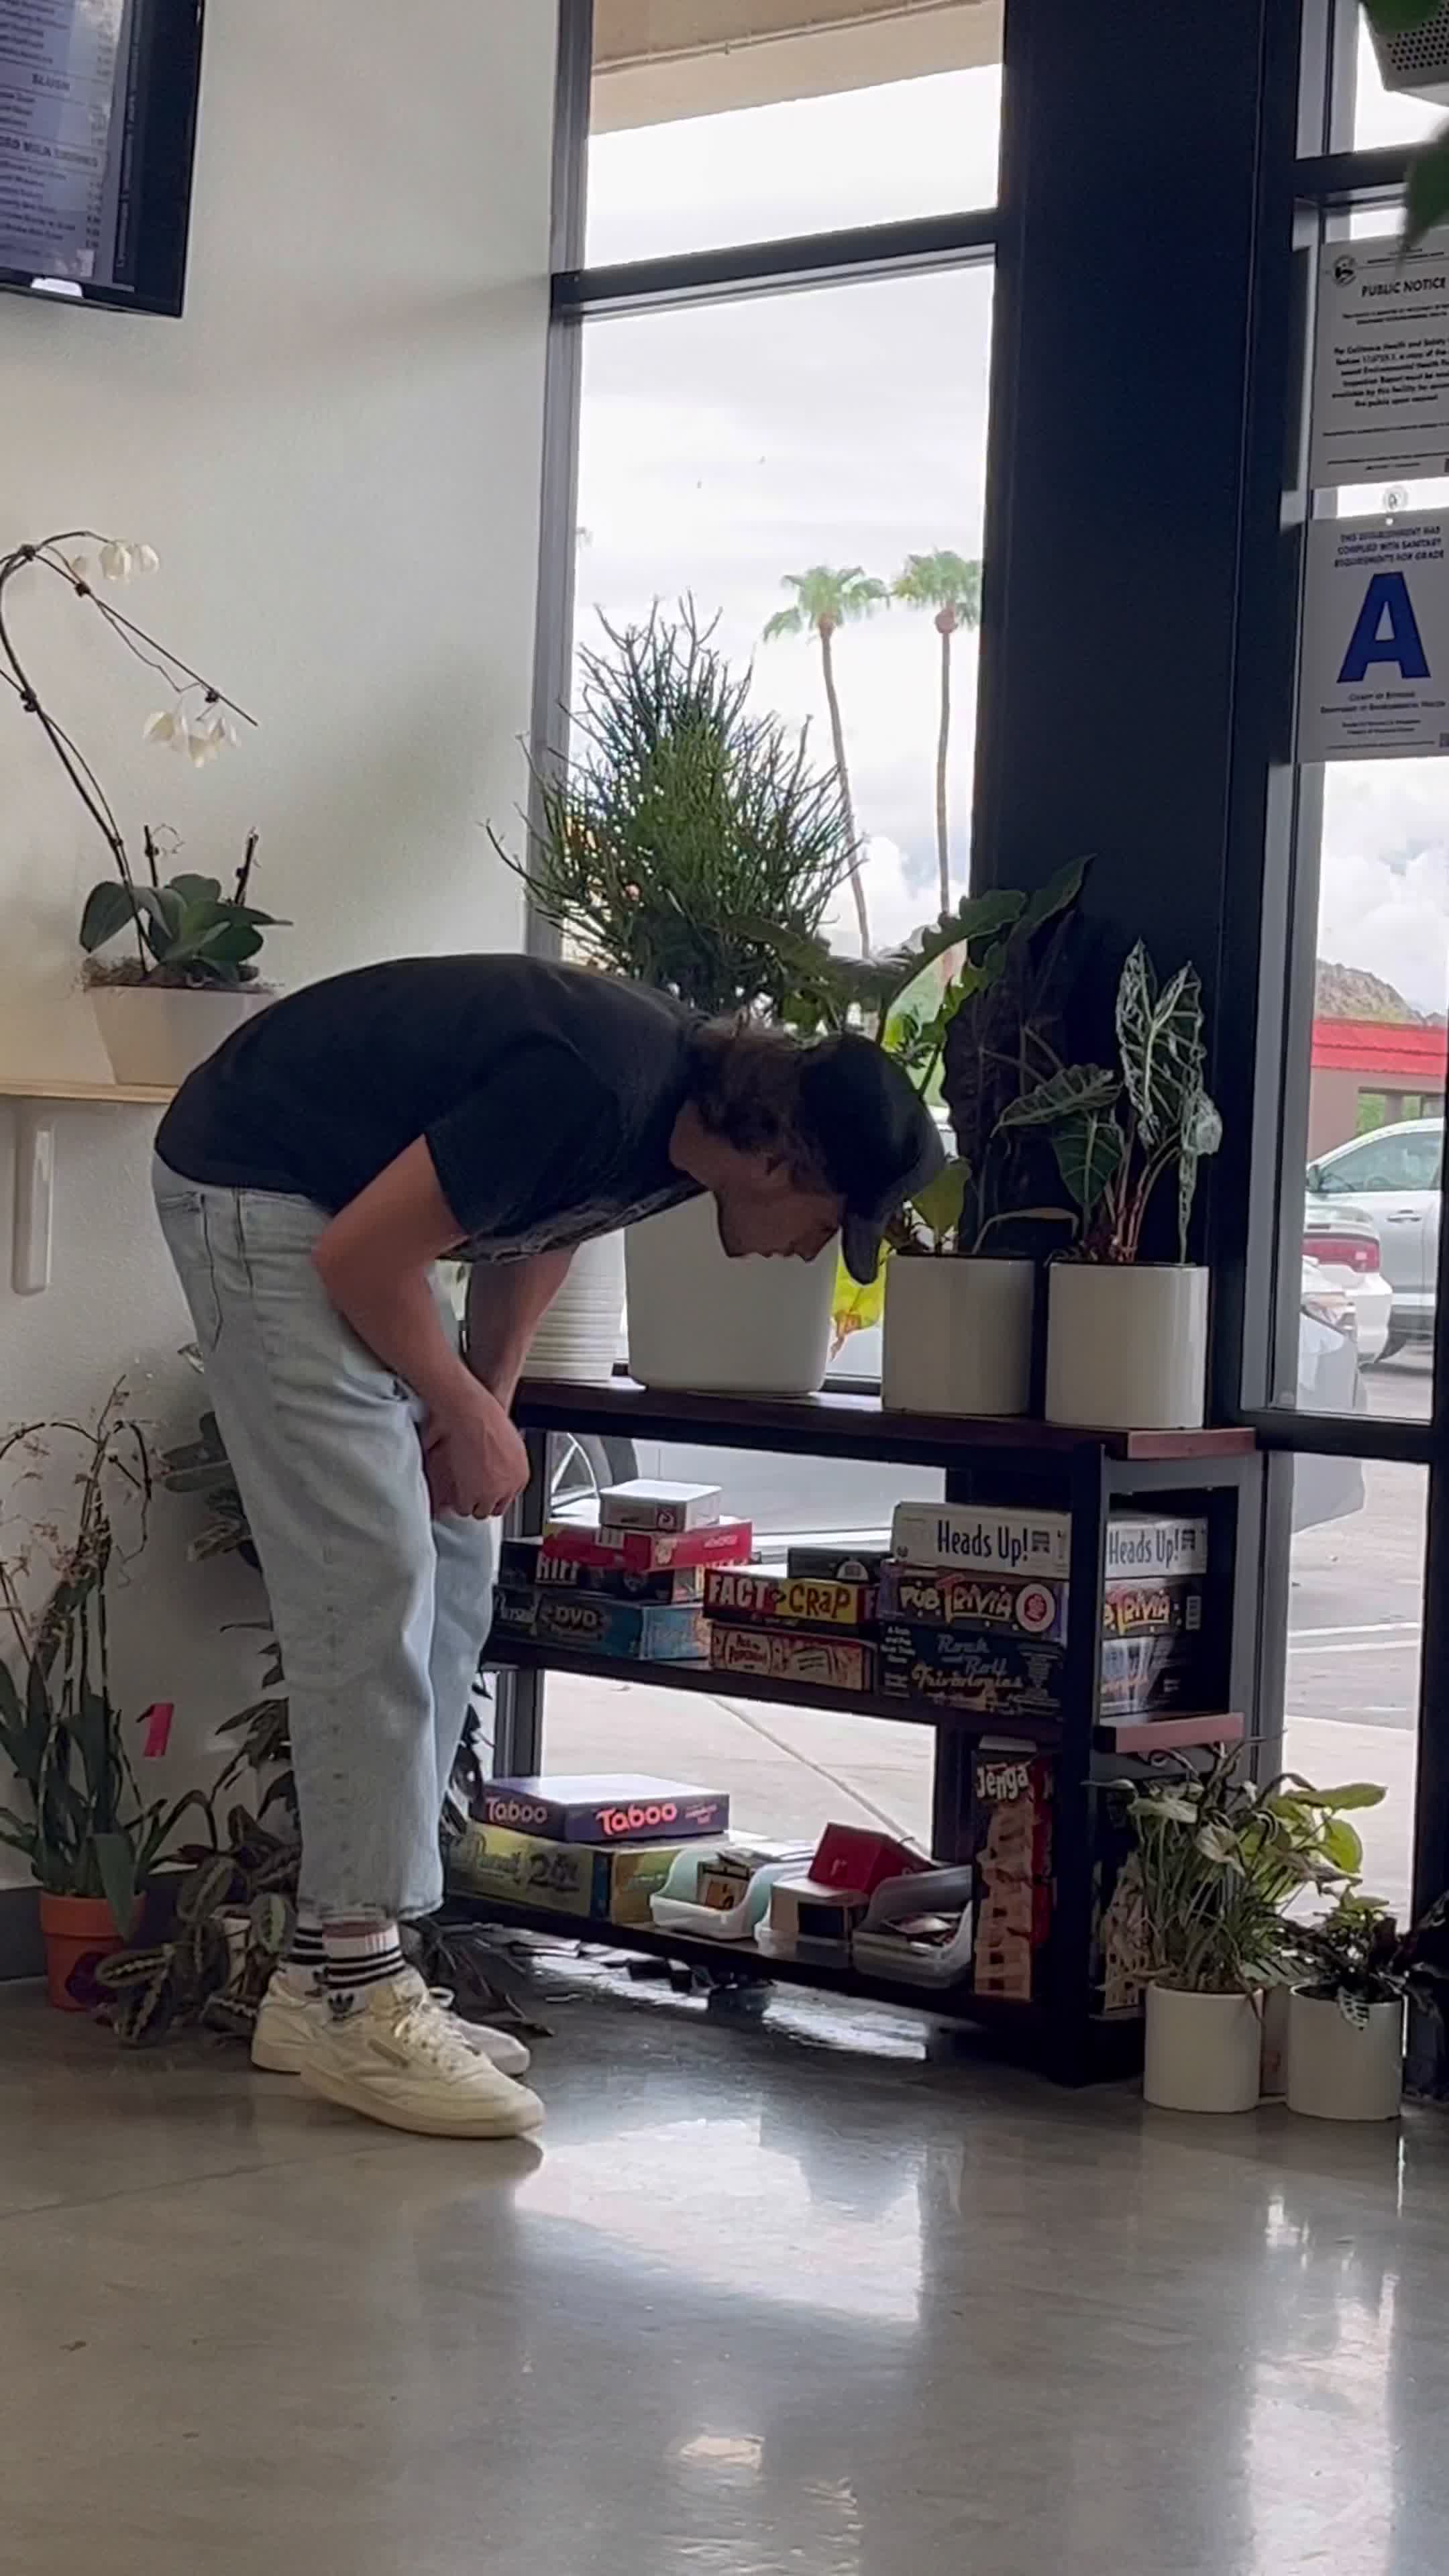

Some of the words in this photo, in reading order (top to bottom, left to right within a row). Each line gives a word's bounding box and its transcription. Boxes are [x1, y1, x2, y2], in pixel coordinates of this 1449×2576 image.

[1362, 281, 1401, 297] PUBLIC
[1403, 276, 1446, 292] NOTICE
[1336, 571, 1432, 684] A
[938, 1519, 991, 1558] Heads
[998, 1526, 1028, 1566] Up!
[1108, 1527, 1152, 1564] Heads
[1155, 1528, 1180, 1568] Up!
[708, 1574, 770, 1610] FACT
[900, 1583, 941, 1610] PUB
[964, 1654, 1008, 1676] Roll
[976, 1762, 1030, 1800] Jenga
[485, 1798, 547, 1824] Taboo
[596, 1802, 678, 1835] Taboo
